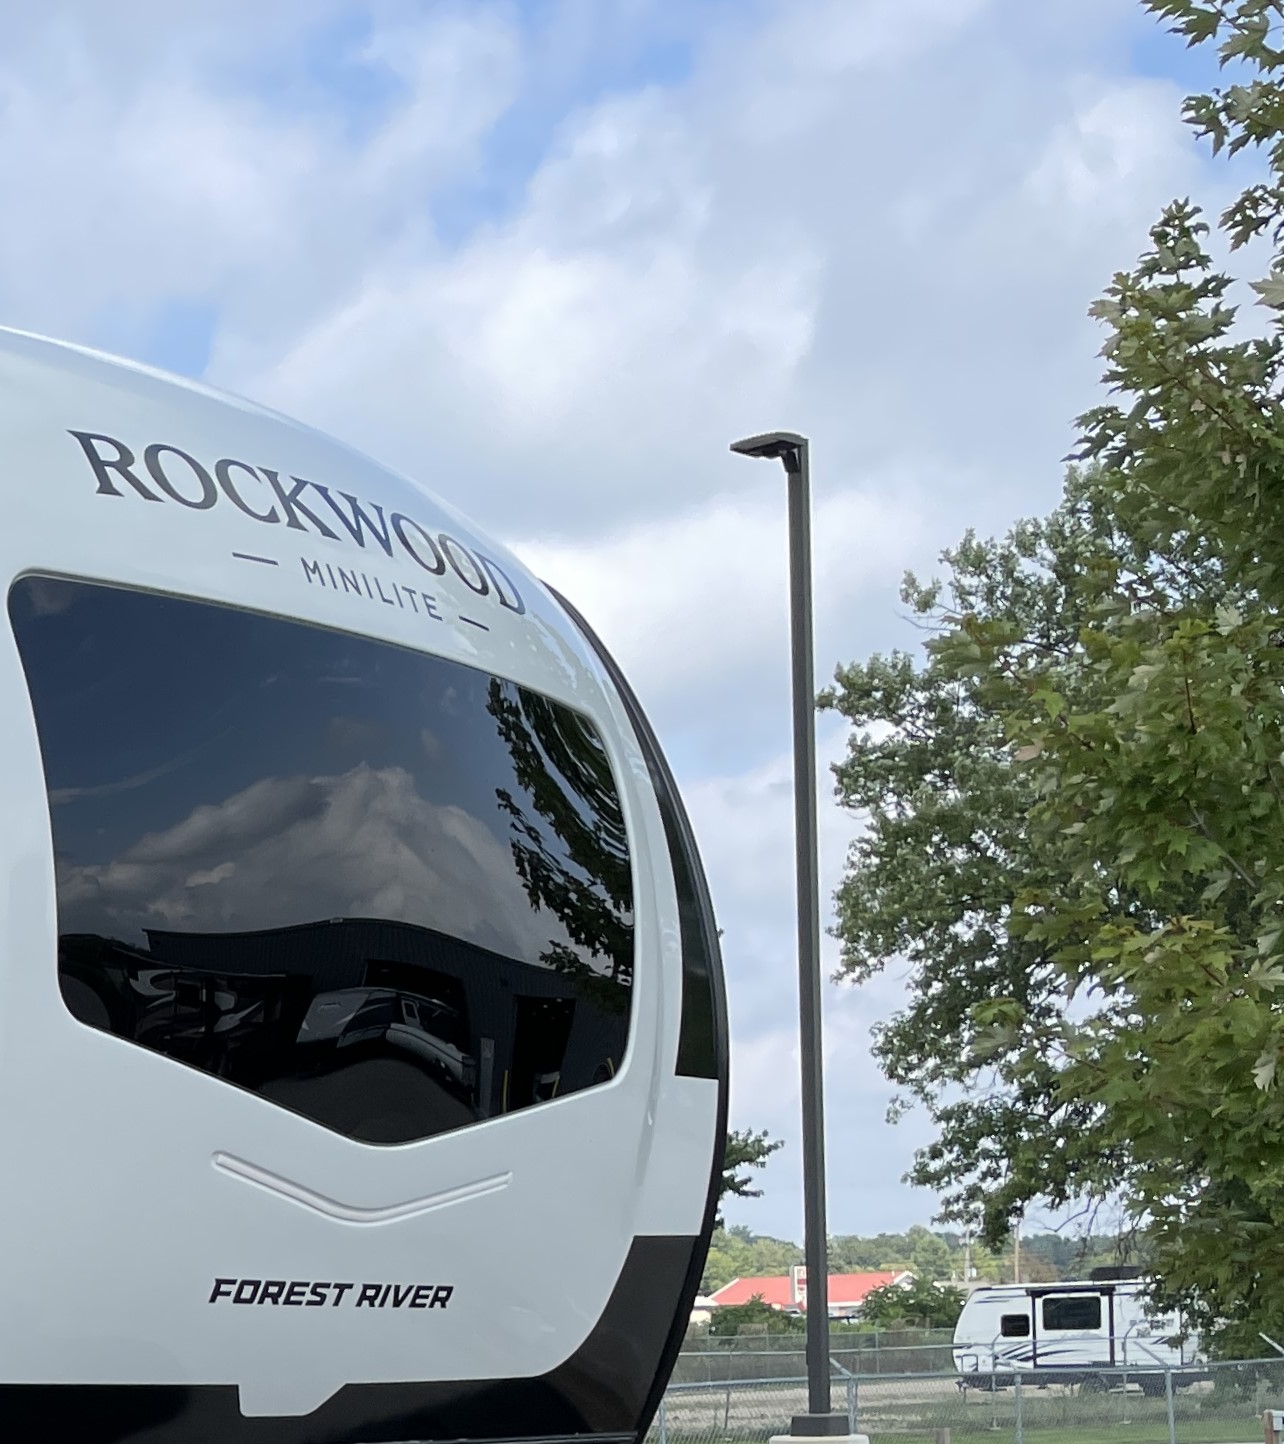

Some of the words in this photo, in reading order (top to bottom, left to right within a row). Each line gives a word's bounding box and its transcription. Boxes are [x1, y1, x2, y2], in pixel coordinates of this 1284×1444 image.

[66, 429, 526, 616] ROCKWOOD
[300, 556, 443, 622] MINILITE
[208, 1278, 354, 1308] FOREST
[354, 1283, 454, 1309] RIVER
